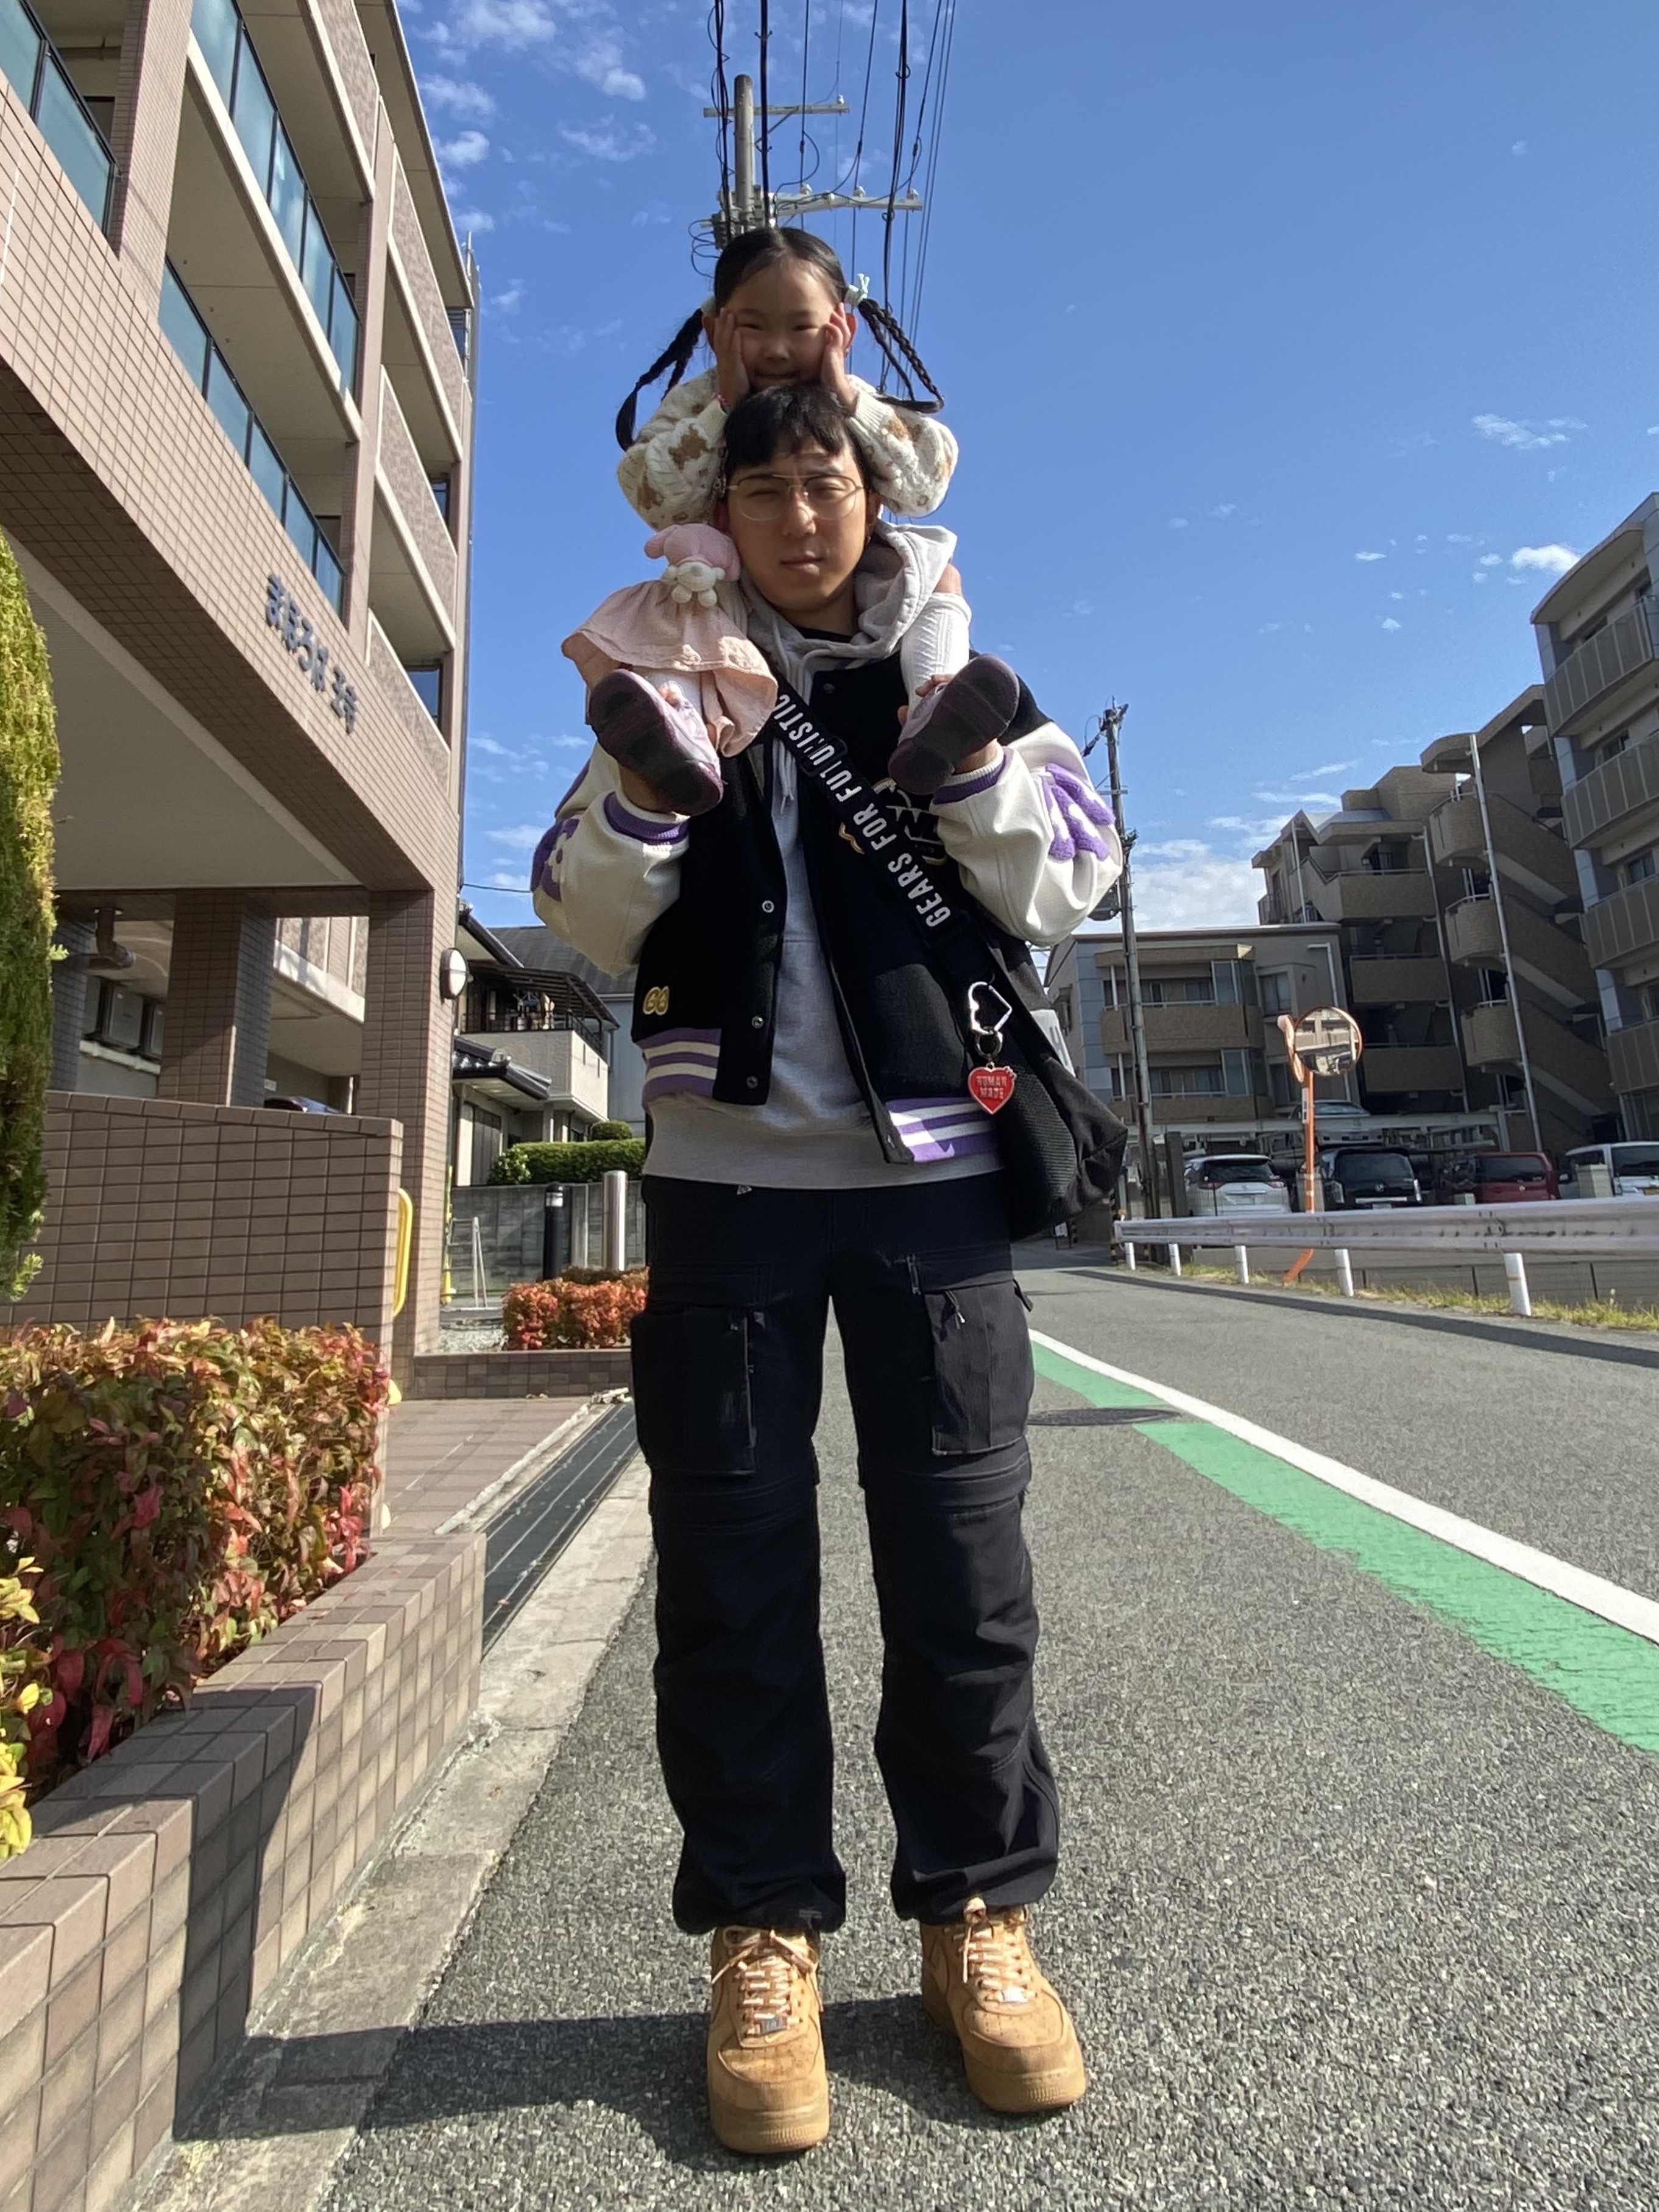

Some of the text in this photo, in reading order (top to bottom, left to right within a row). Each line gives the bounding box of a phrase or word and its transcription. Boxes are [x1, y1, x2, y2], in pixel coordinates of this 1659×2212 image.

[773, 694, 951, 927] GEARS FOR FUTUISTIC
[977, 1076, 1006, 1086] HUMAN
[980, 1088, 1004, 1099] MADE
